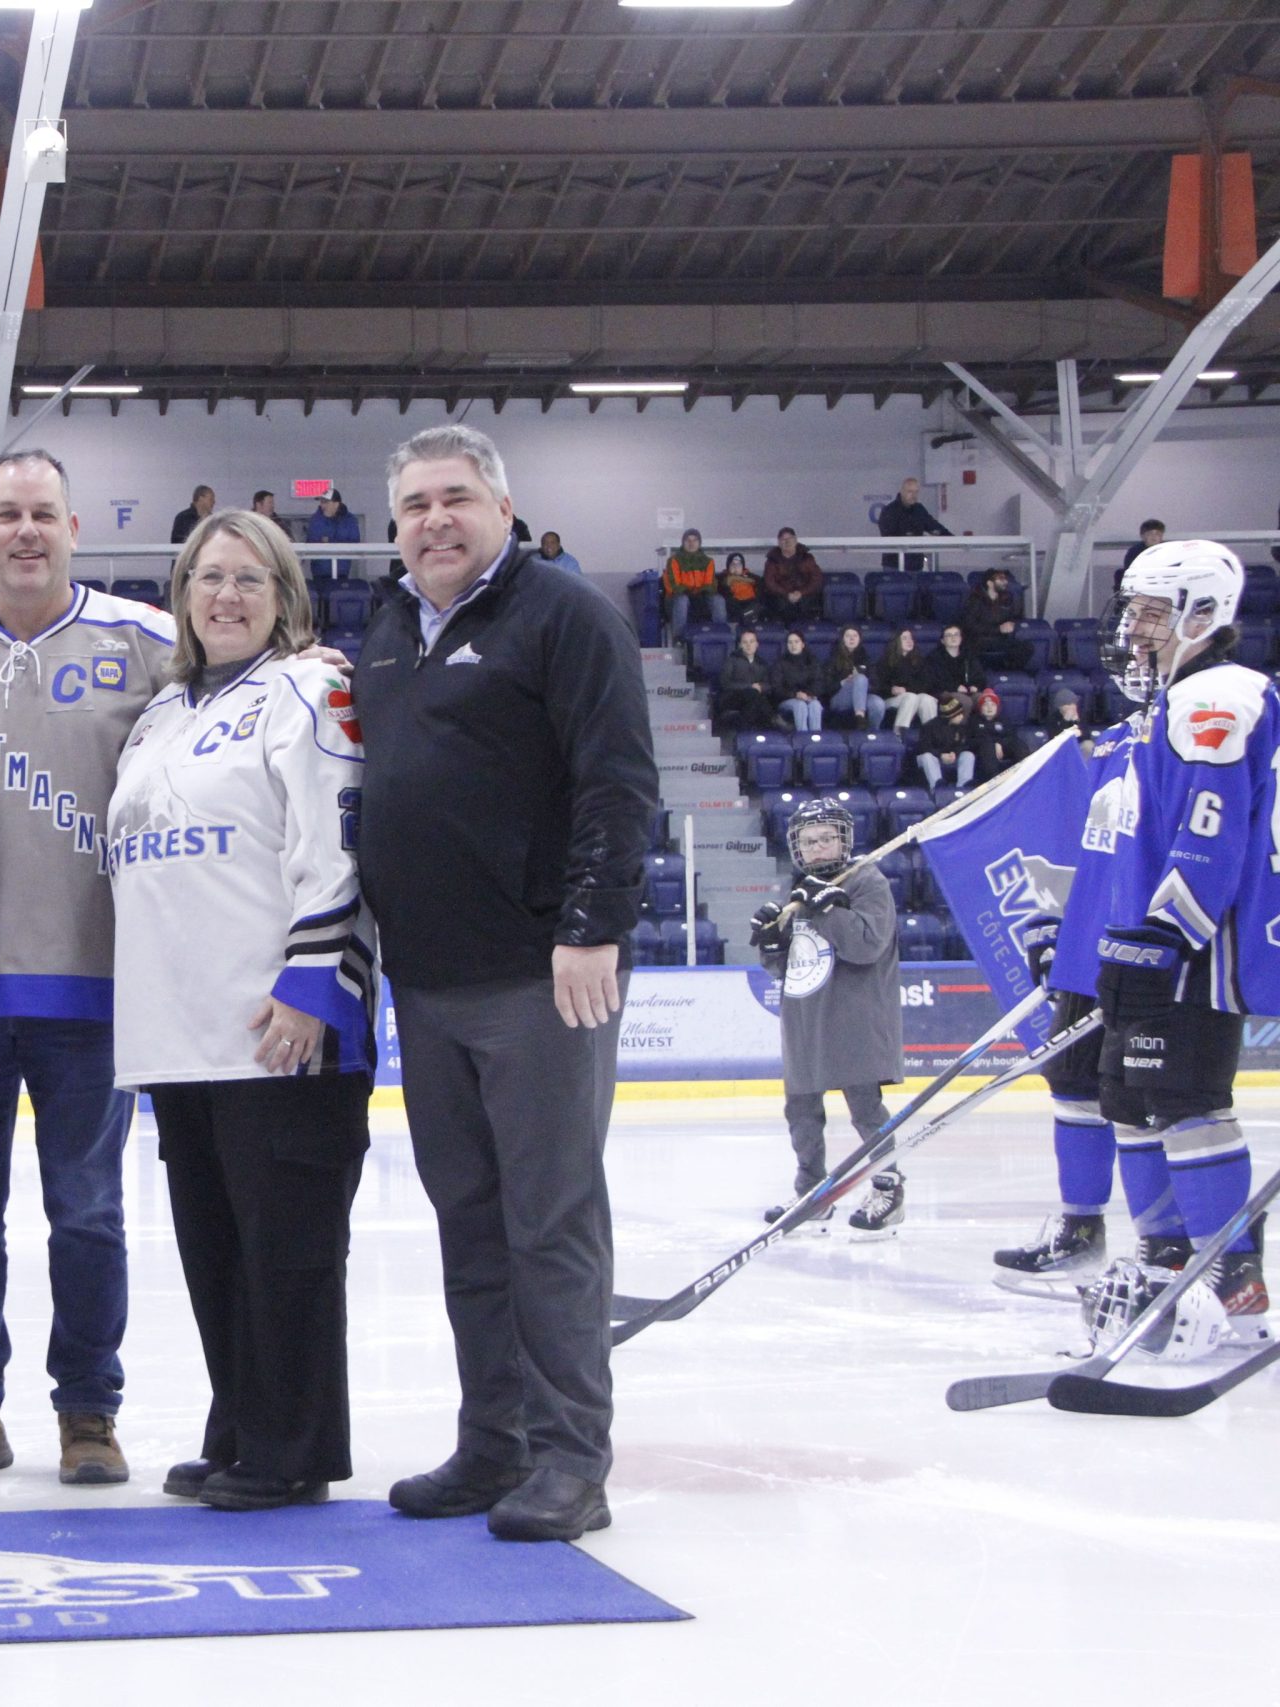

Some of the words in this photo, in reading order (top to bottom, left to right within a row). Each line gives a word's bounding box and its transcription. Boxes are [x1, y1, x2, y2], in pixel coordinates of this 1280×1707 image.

[117, 507, 132, 529] F
[100, 667, 119, 679] NAPA
[51, 663, 87, 703] C
[193, 721, 232, 756] C
[691, 763, 727, 774] Gilmyr
[1187, 789, 1224, 838] 6
[726, 840, 763, 853] Gilmyr
[1169, 849, 1212, 865] ERCIER
[620, 1036, 674, 1048] RIVEST
